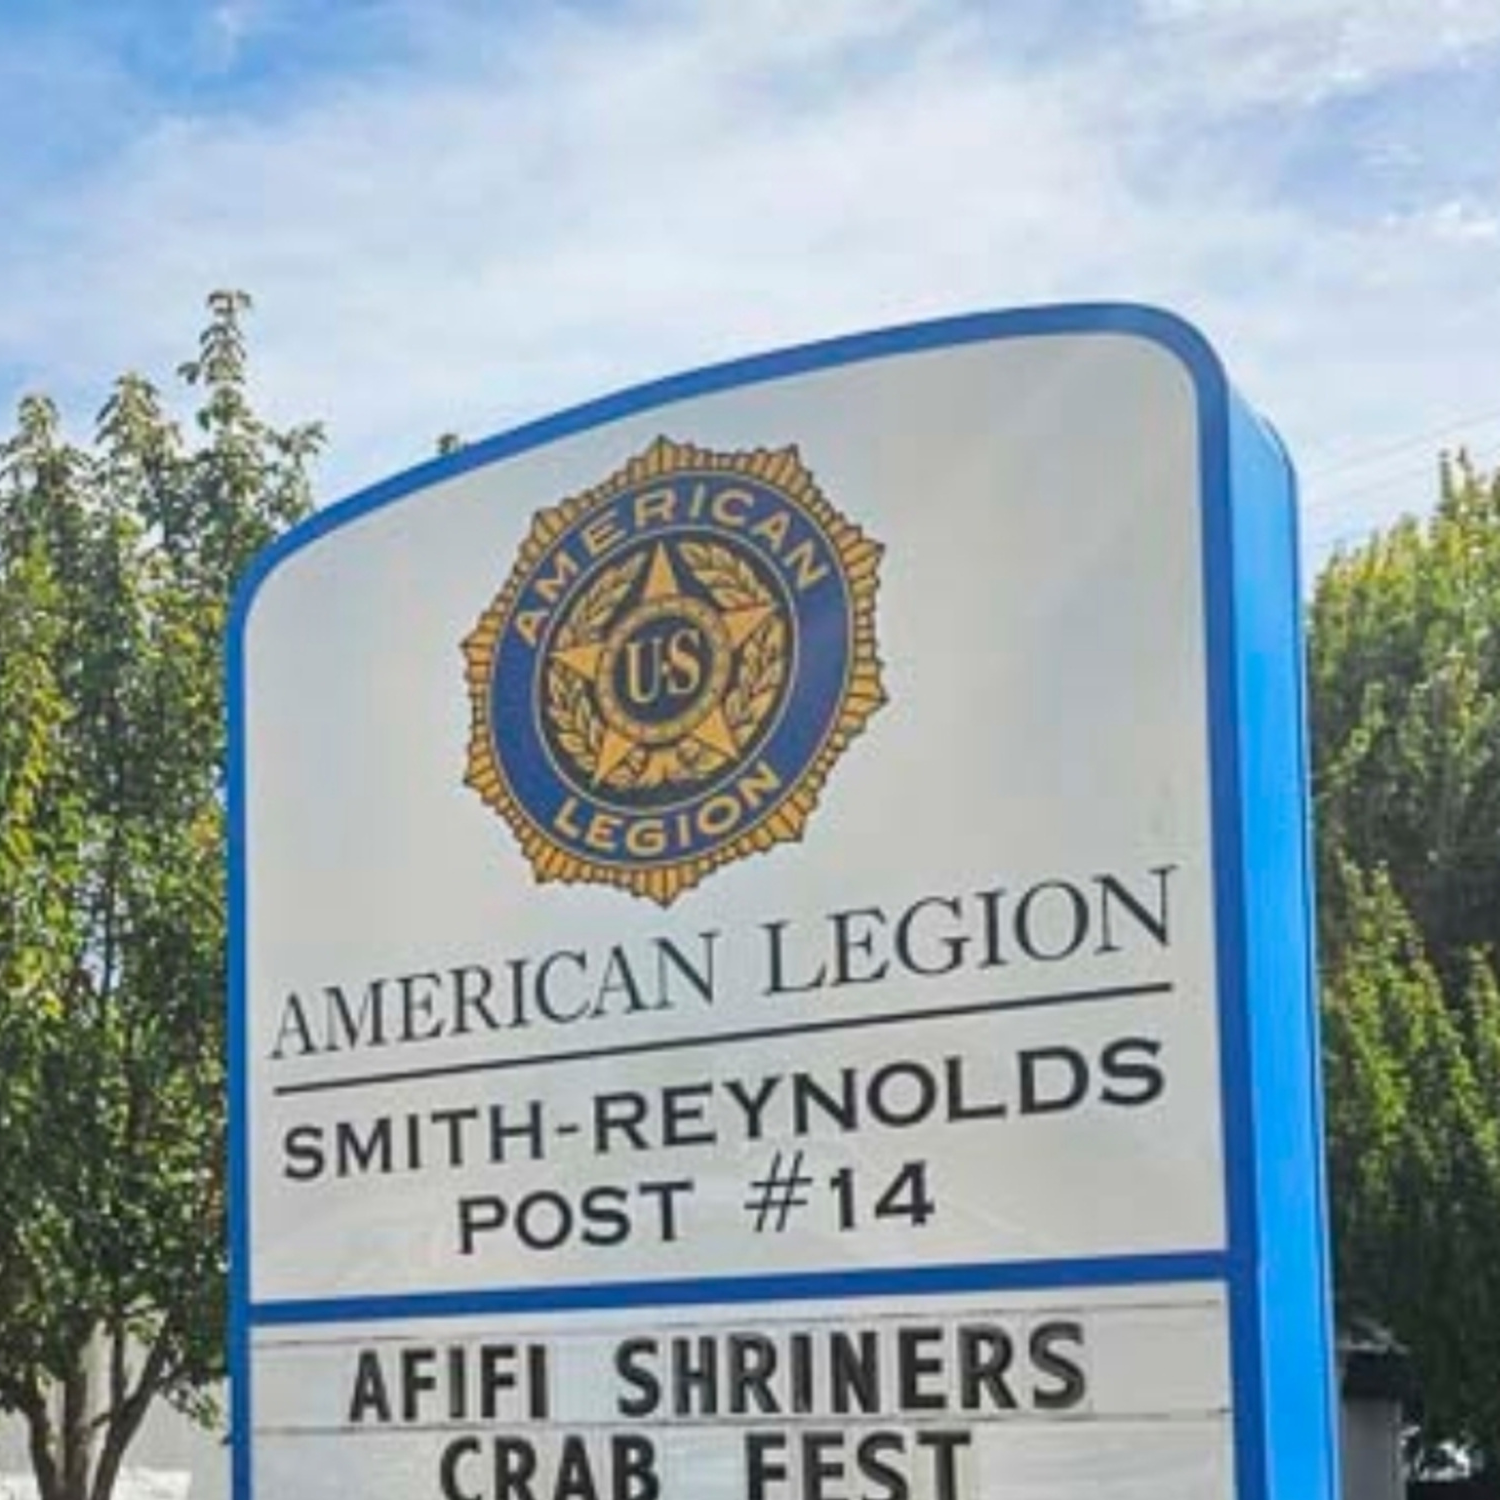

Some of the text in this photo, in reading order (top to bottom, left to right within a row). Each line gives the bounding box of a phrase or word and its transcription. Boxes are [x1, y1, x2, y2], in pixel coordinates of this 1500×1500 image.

[514, 484, 831, 648] AMERICAN
[554, 762, 783, 856] LEGION
[269, 866, 1178, 1060] AMERICAN LEGION
[283, 1036, 1166, 1181] SMITH-REYNOLDS
[458, 1149, 935, 1255] POST #14
[349, 1322, 1088, 1423] AFIFI SHRINERS
